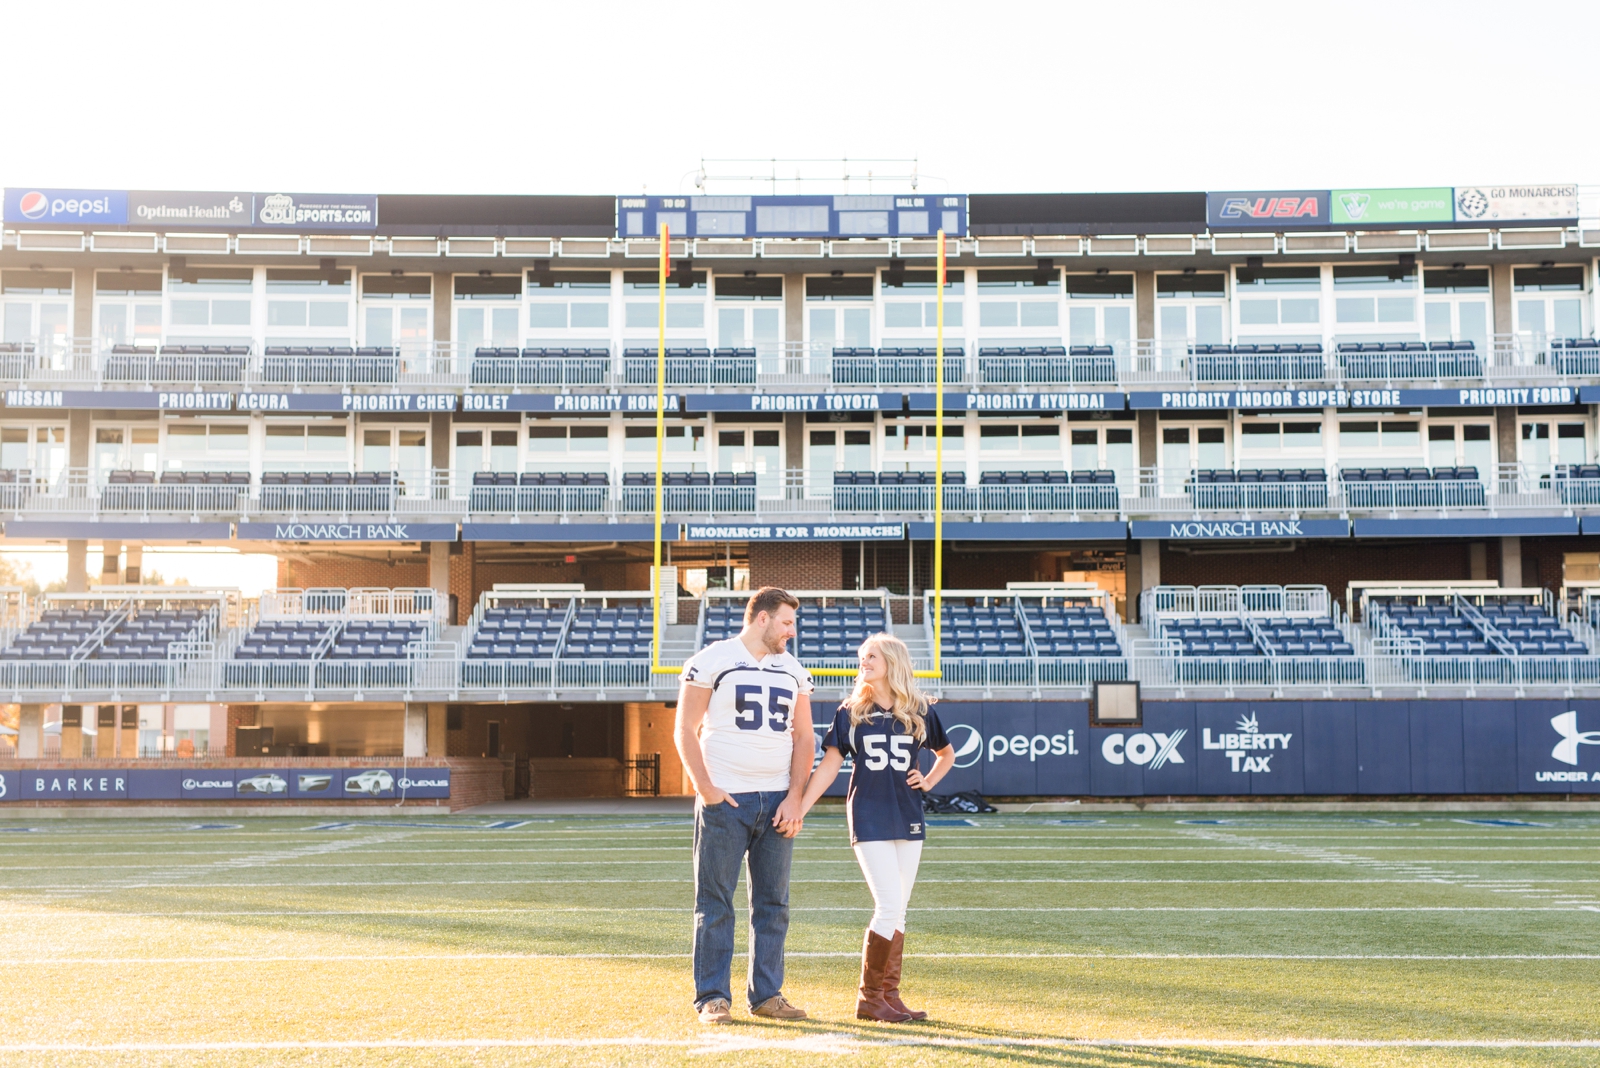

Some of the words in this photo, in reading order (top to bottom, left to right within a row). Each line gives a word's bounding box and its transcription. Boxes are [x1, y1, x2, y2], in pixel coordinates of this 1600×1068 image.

[1491, 189, 1505, 199] GO
[1509, 187, 1575, 198] MONARCHS!
[51, 196, 110, 216] pepsi
[622, 198, 646, 209] DOWN
[663, 198, 673, 209] TO
[674, 198, 686, 209] GO
[896, 198, 913, 208] BALL
[914, 198, 925, 208] ON
[943, 197, 958, 208] QTR
[1411, 200, 1446, 212] game
[7, 391, 63, 407] NISSAN
[159, 393, 229, 410] PRIORITY
[239, 394, 289, 410] ACURA
[343, 395, 411, 410] PRIORITY
[555, 395, 622, 411] PRIORITY
[628, 395, 679, 410] HONDA
[751, 395, 819, 411] PRIORITY
[825, 395, 879, 410] TOYOTA
[967, 395, 1035, 410] PRIORITY
[1040, 394, 1105, 409] HYUNDAI
[1162, 393, 1230, 408] PRIORITY
[1236, 392, 1293, 408] INDOOR
[1298, 391, 1346, 406] SUPER
[1354, 390, 1401, 406] STORE
[1460, 389, 1528, 405] PRIORITY
[1533, 388, 1571, 404] FORD
[276, 525, 361, 539] MONARCH
[367, 525, 409, 539] BANK
[690, 526, 771, 538] MONARCH
[775, 527, 809, 538] FOR
[813, 525, 902, 538] MONARCHS
[1170, 522, 1255, 537] MONARCH
[1261, 521, 1303, 536] BANK
[1097, 561, 1120, 572] Level
[735, 685, 793, 732] 55
[988, 729, 1078, 762] pepsi
[1203, 728, 1292, 750] LIBERTY
[862, 734, 915, 772] 55
[1102, 729, 1188, 770] COX
[1225, 751, 1271, 773] TAX
[196, 780, 233, 788] LEXUS
[411, 779, 448, 787] LEXUS
[1535, 771, 1588, 782] UNDER
[35, 778, 125, 792] BARKER
